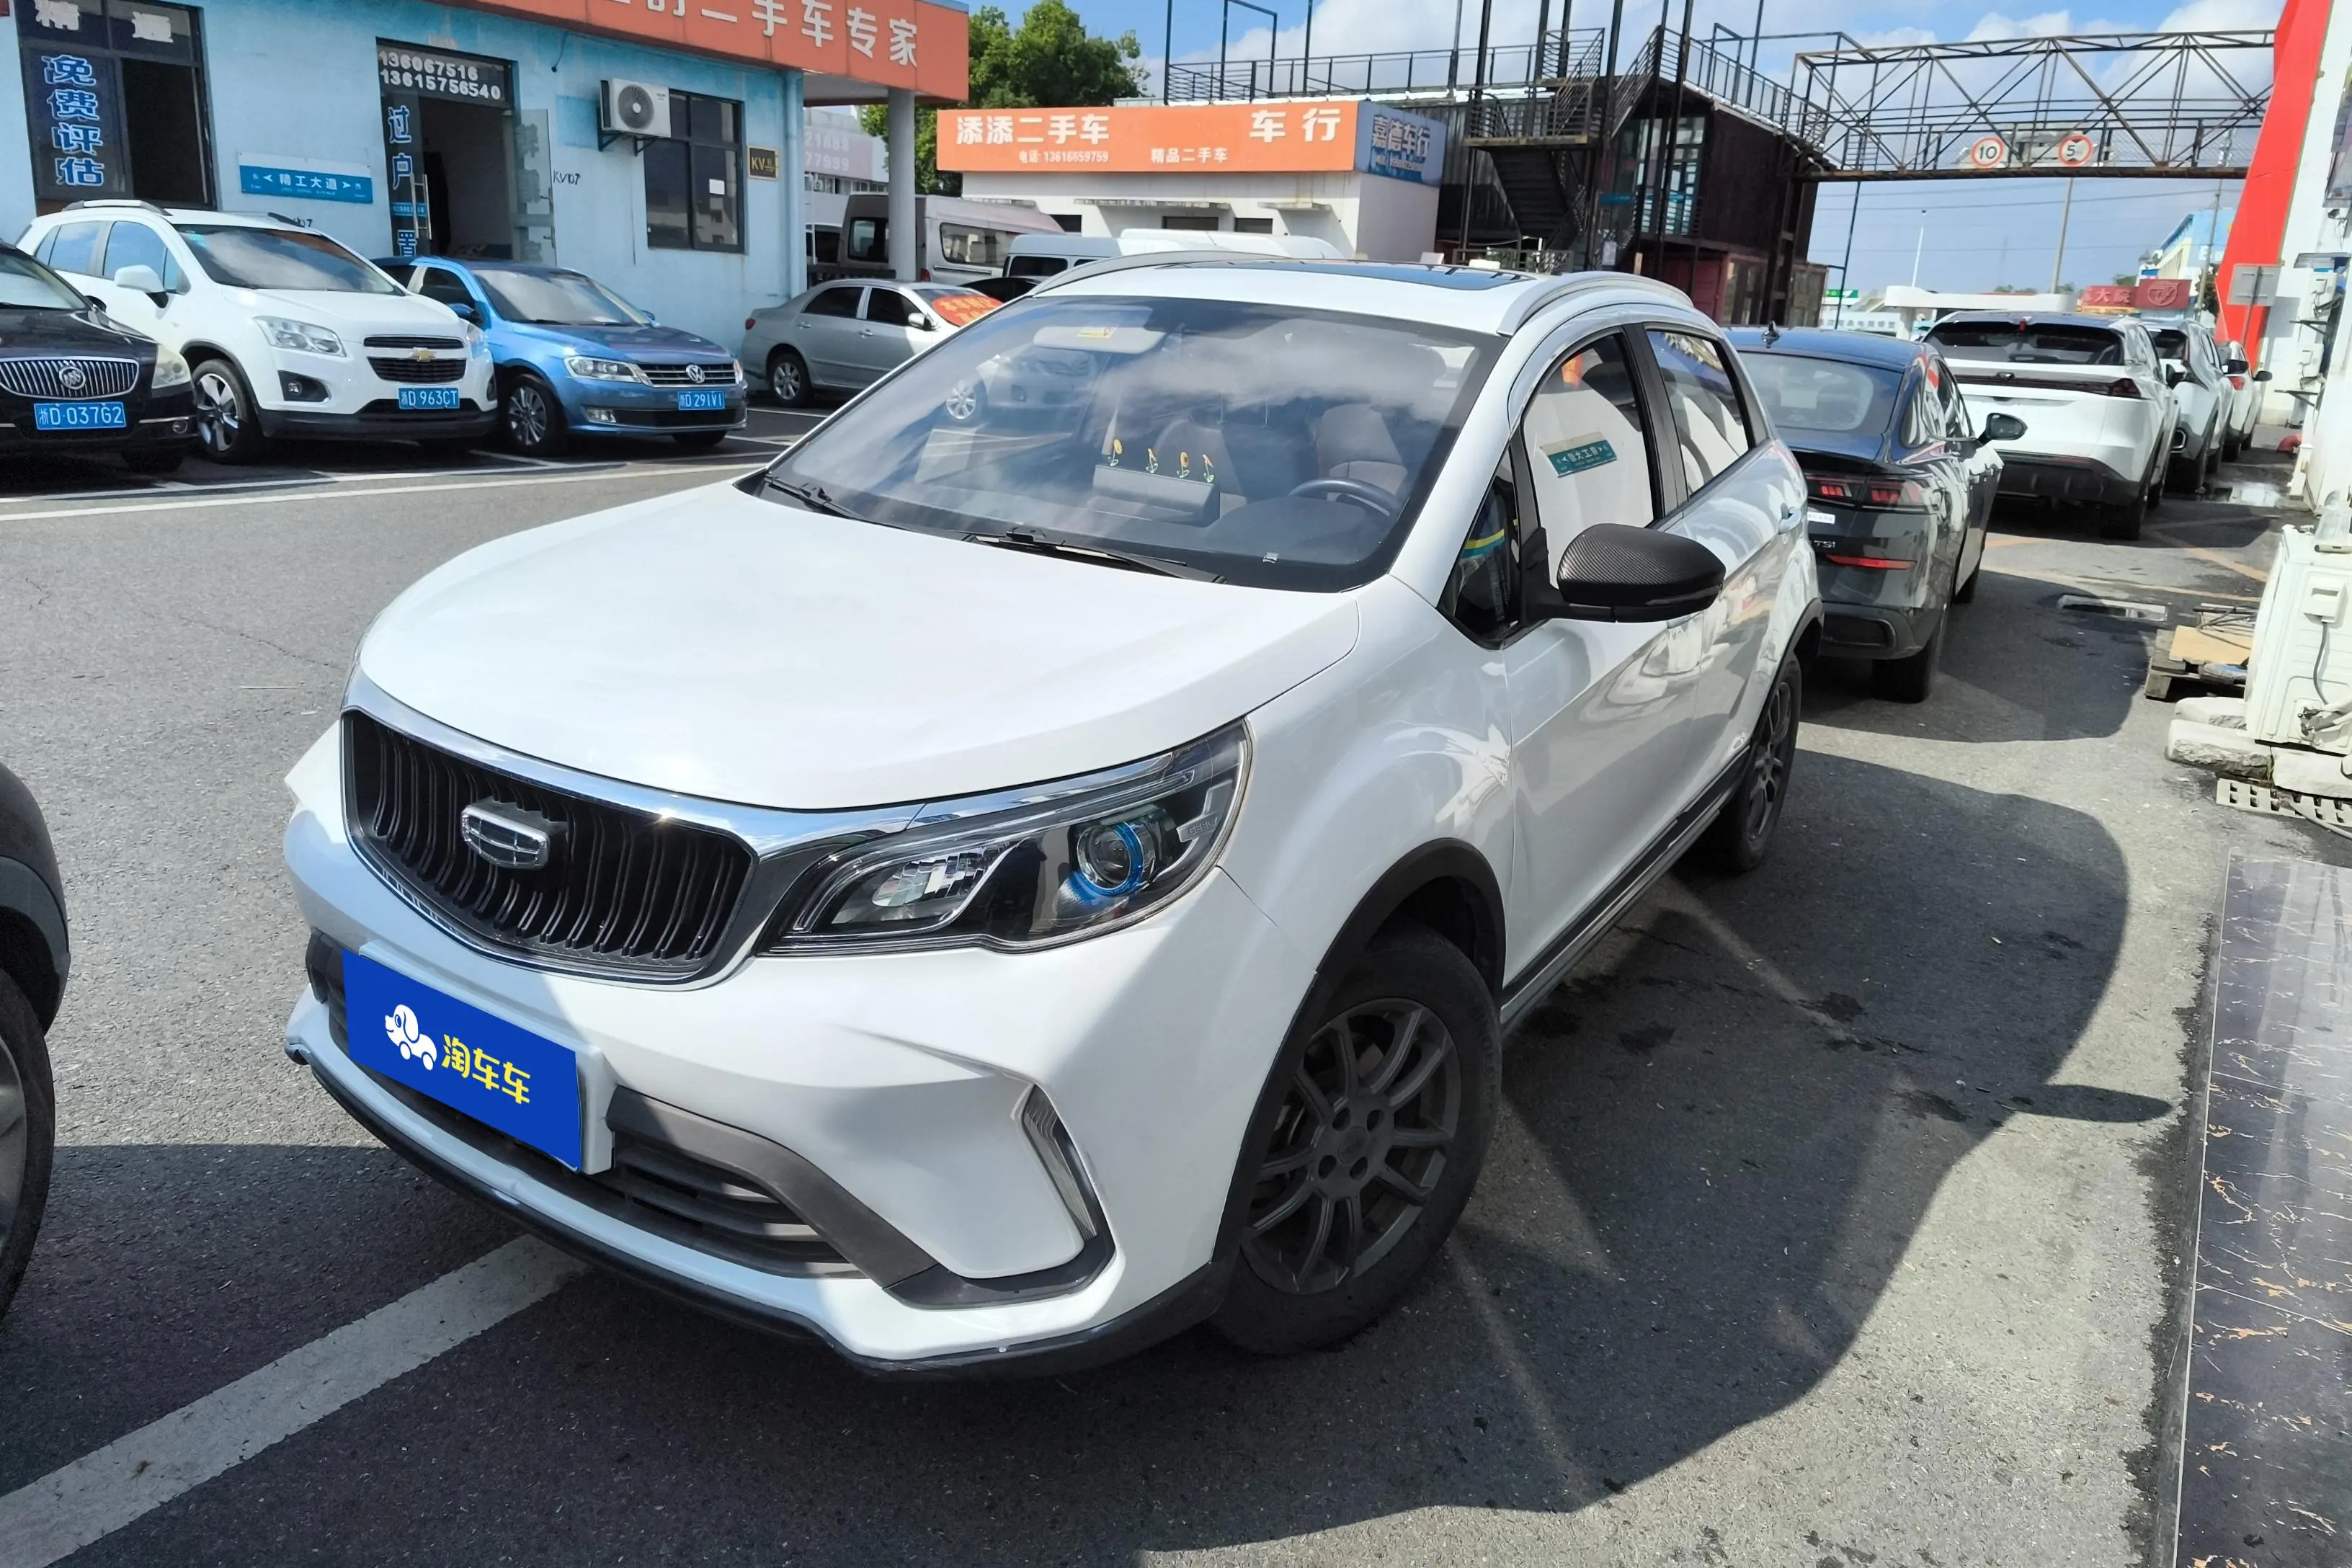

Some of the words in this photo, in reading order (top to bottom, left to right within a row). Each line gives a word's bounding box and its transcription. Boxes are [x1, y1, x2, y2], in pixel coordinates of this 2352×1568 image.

[380, 68, 502, 100] 13615756540
[50, 54, 104, 187] 免费评估
[956, 113, 1110, 145] 添添二手车
[1151, 146, 1228, 164] 精品二手车
[1979, 146, 1997, 159] 10
